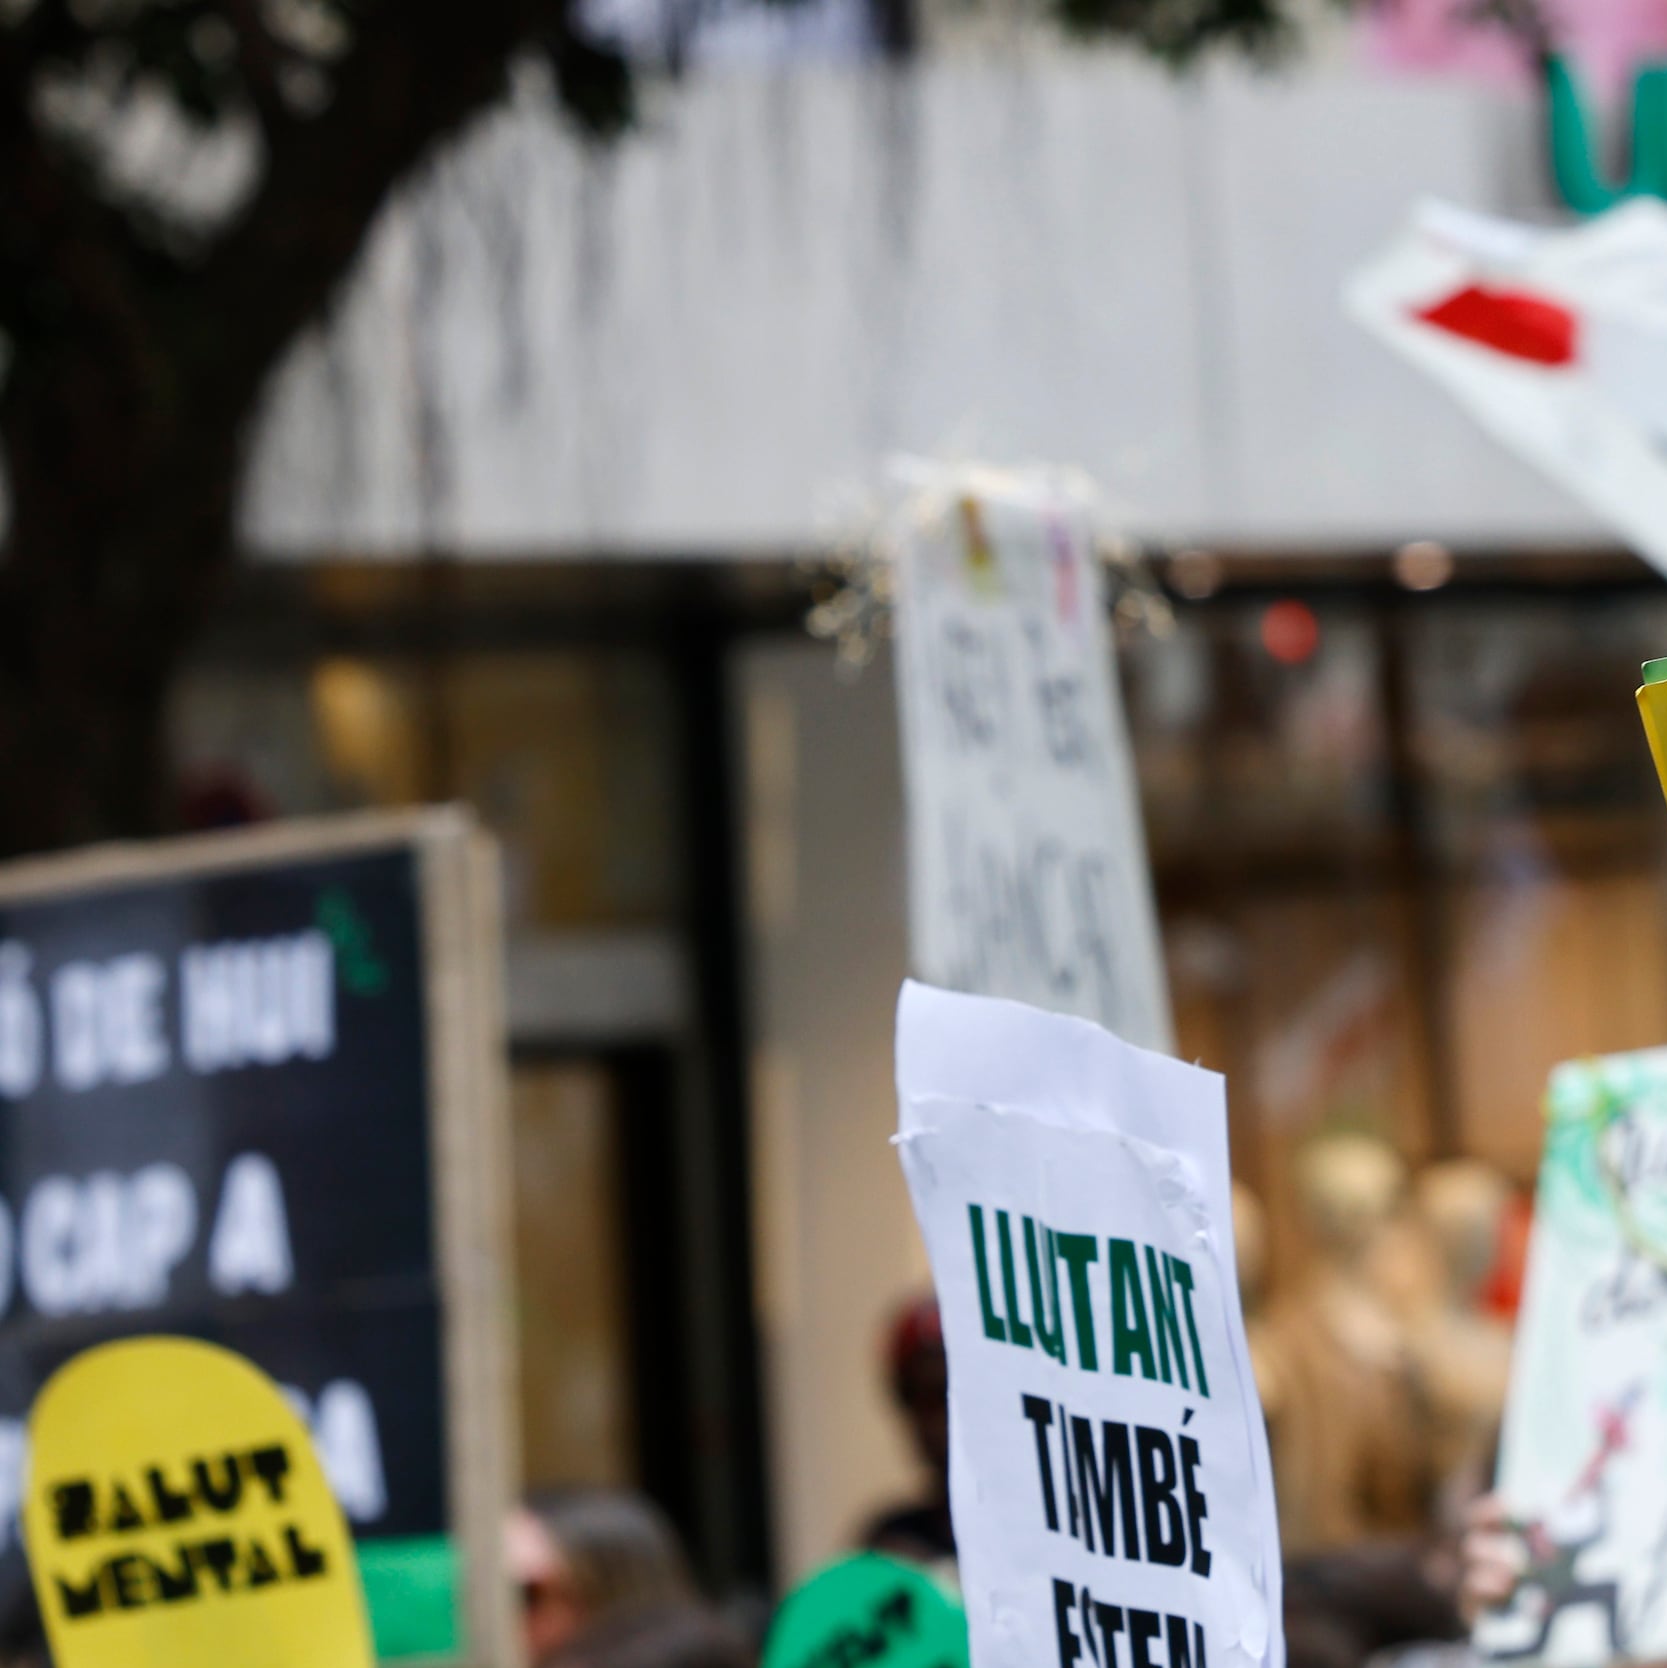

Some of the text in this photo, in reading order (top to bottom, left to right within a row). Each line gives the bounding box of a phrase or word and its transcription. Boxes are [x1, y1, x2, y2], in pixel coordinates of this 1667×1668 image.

[21, 1170, 199, 1316] CAP
[208, 1151, 294, 1296] A
[1020, 1393, 1213, 1579] TAMBÉ
[56, 1522, 330, 1624] MENTAL
